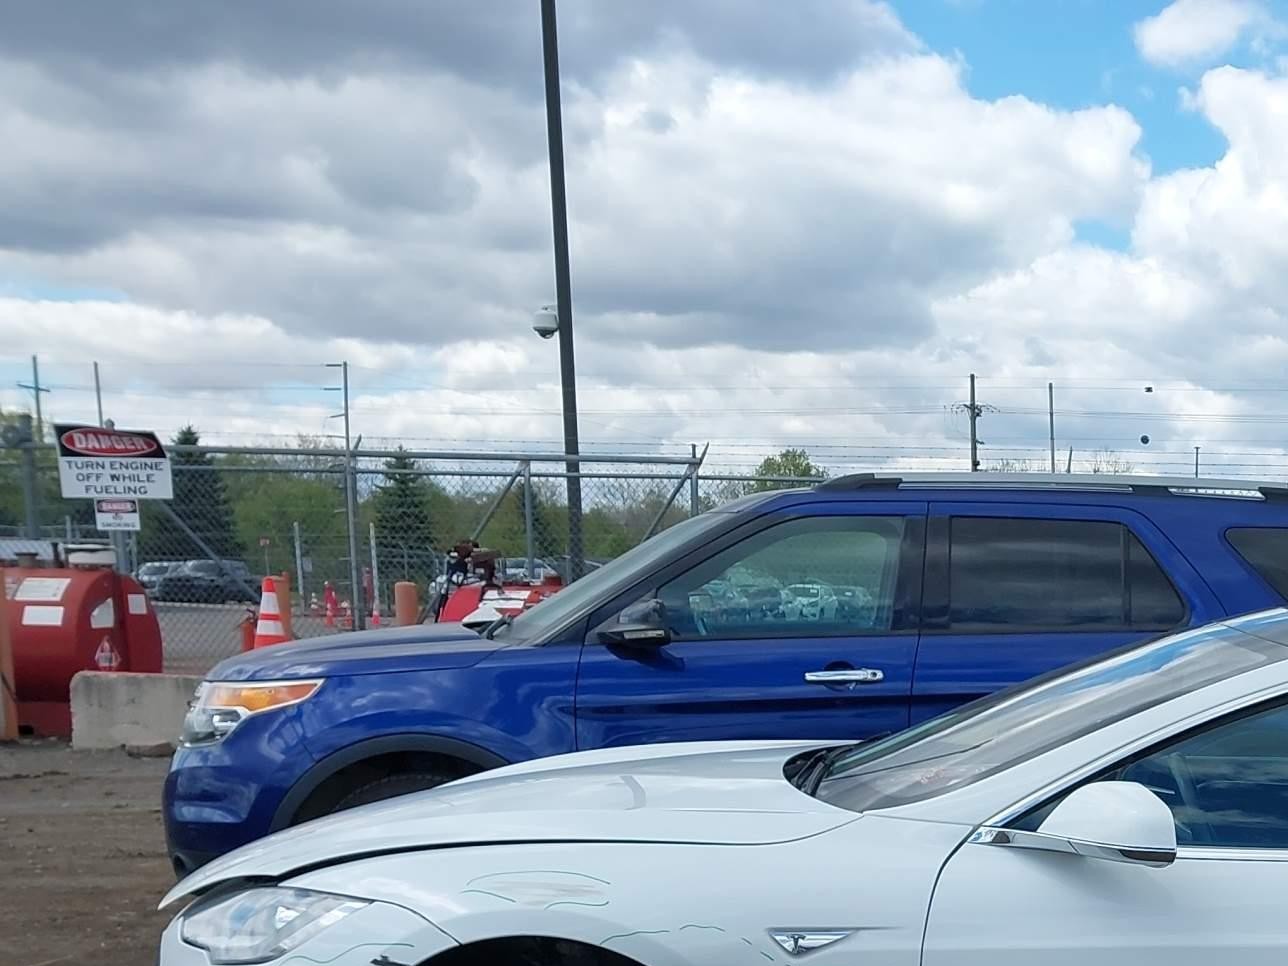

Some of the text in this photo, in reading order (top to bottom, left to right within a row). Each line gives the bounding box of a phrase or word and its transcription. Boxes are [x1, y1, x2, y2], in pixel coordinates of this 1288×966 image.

[72, 433, 148, 450] DANGER
[65, 460, 164, 471] TURN ENGINE
[75, 473, 155, 483] OFF WHILE
[84, 485, 148, 495] FUELING
